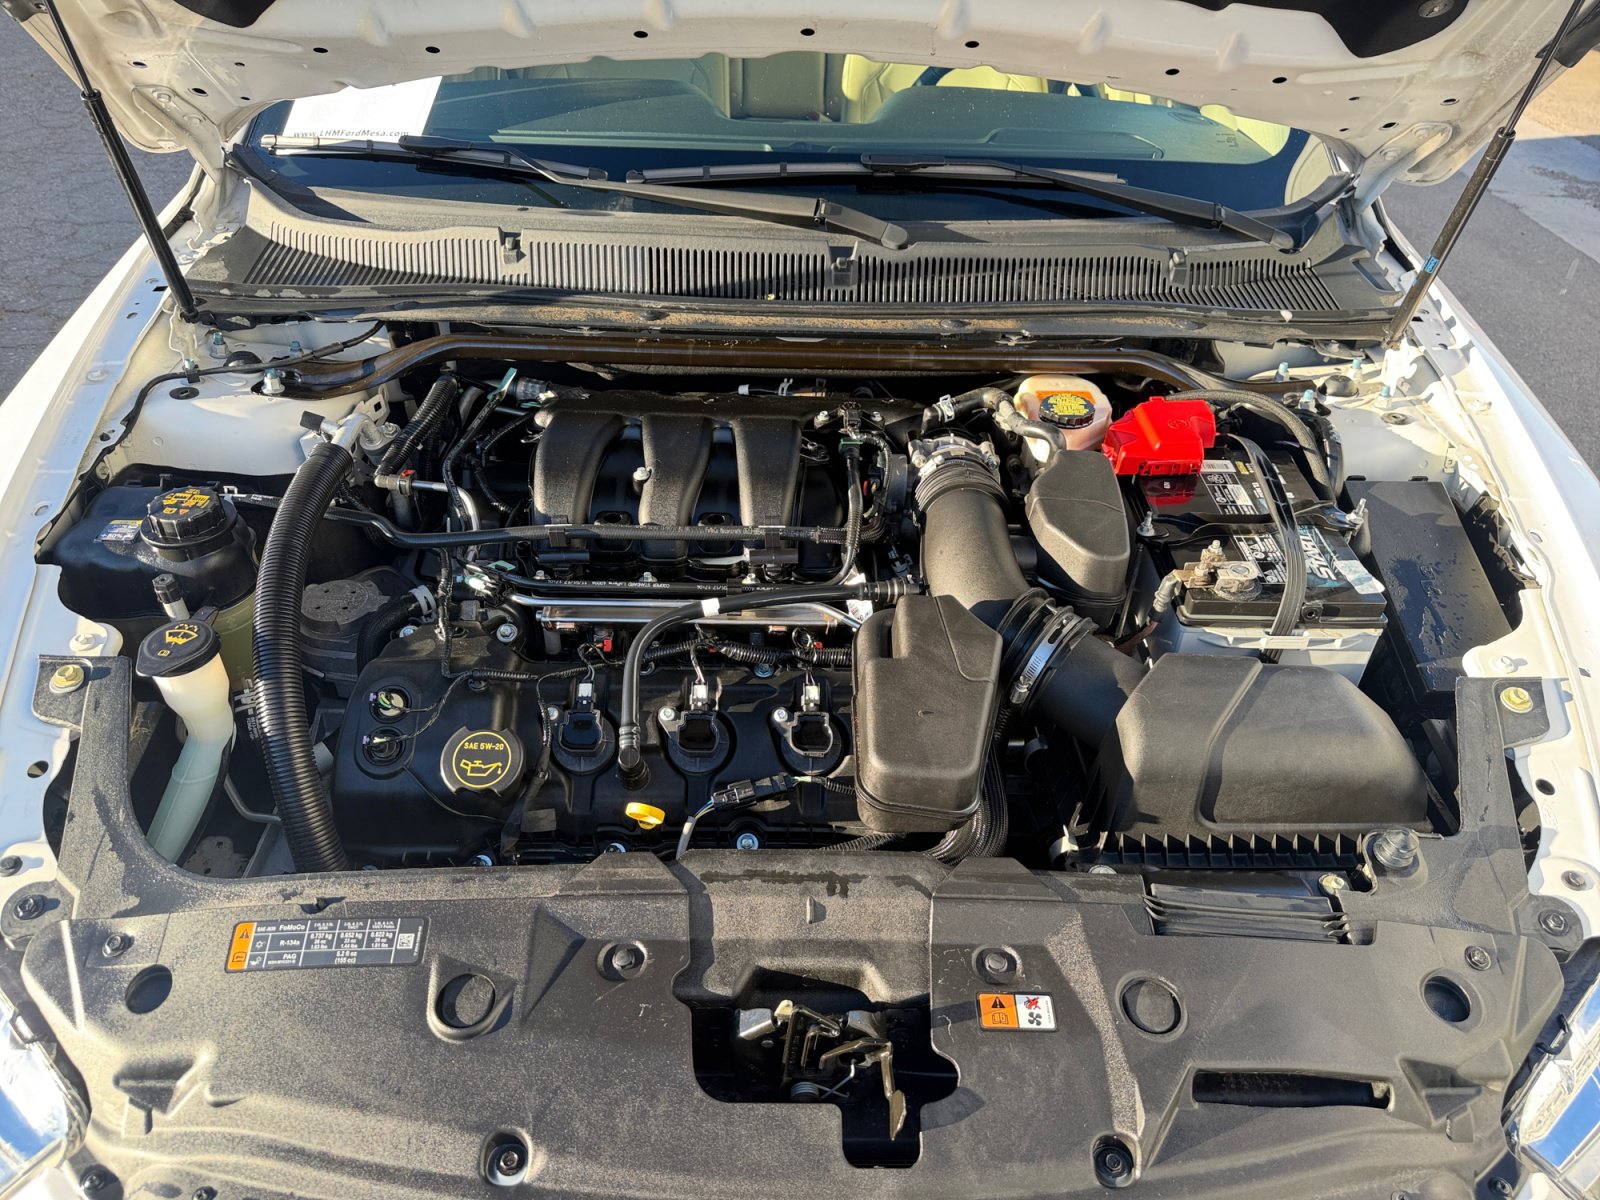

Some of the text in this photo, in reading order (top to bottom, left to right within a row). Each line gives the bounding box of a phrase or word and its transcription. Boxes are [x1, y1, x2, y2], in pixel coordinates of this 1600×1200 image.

[293, 129, 409, 139] www.LHMFordMesa.com
[464, 742, 504, 750] SAE 5W-20
